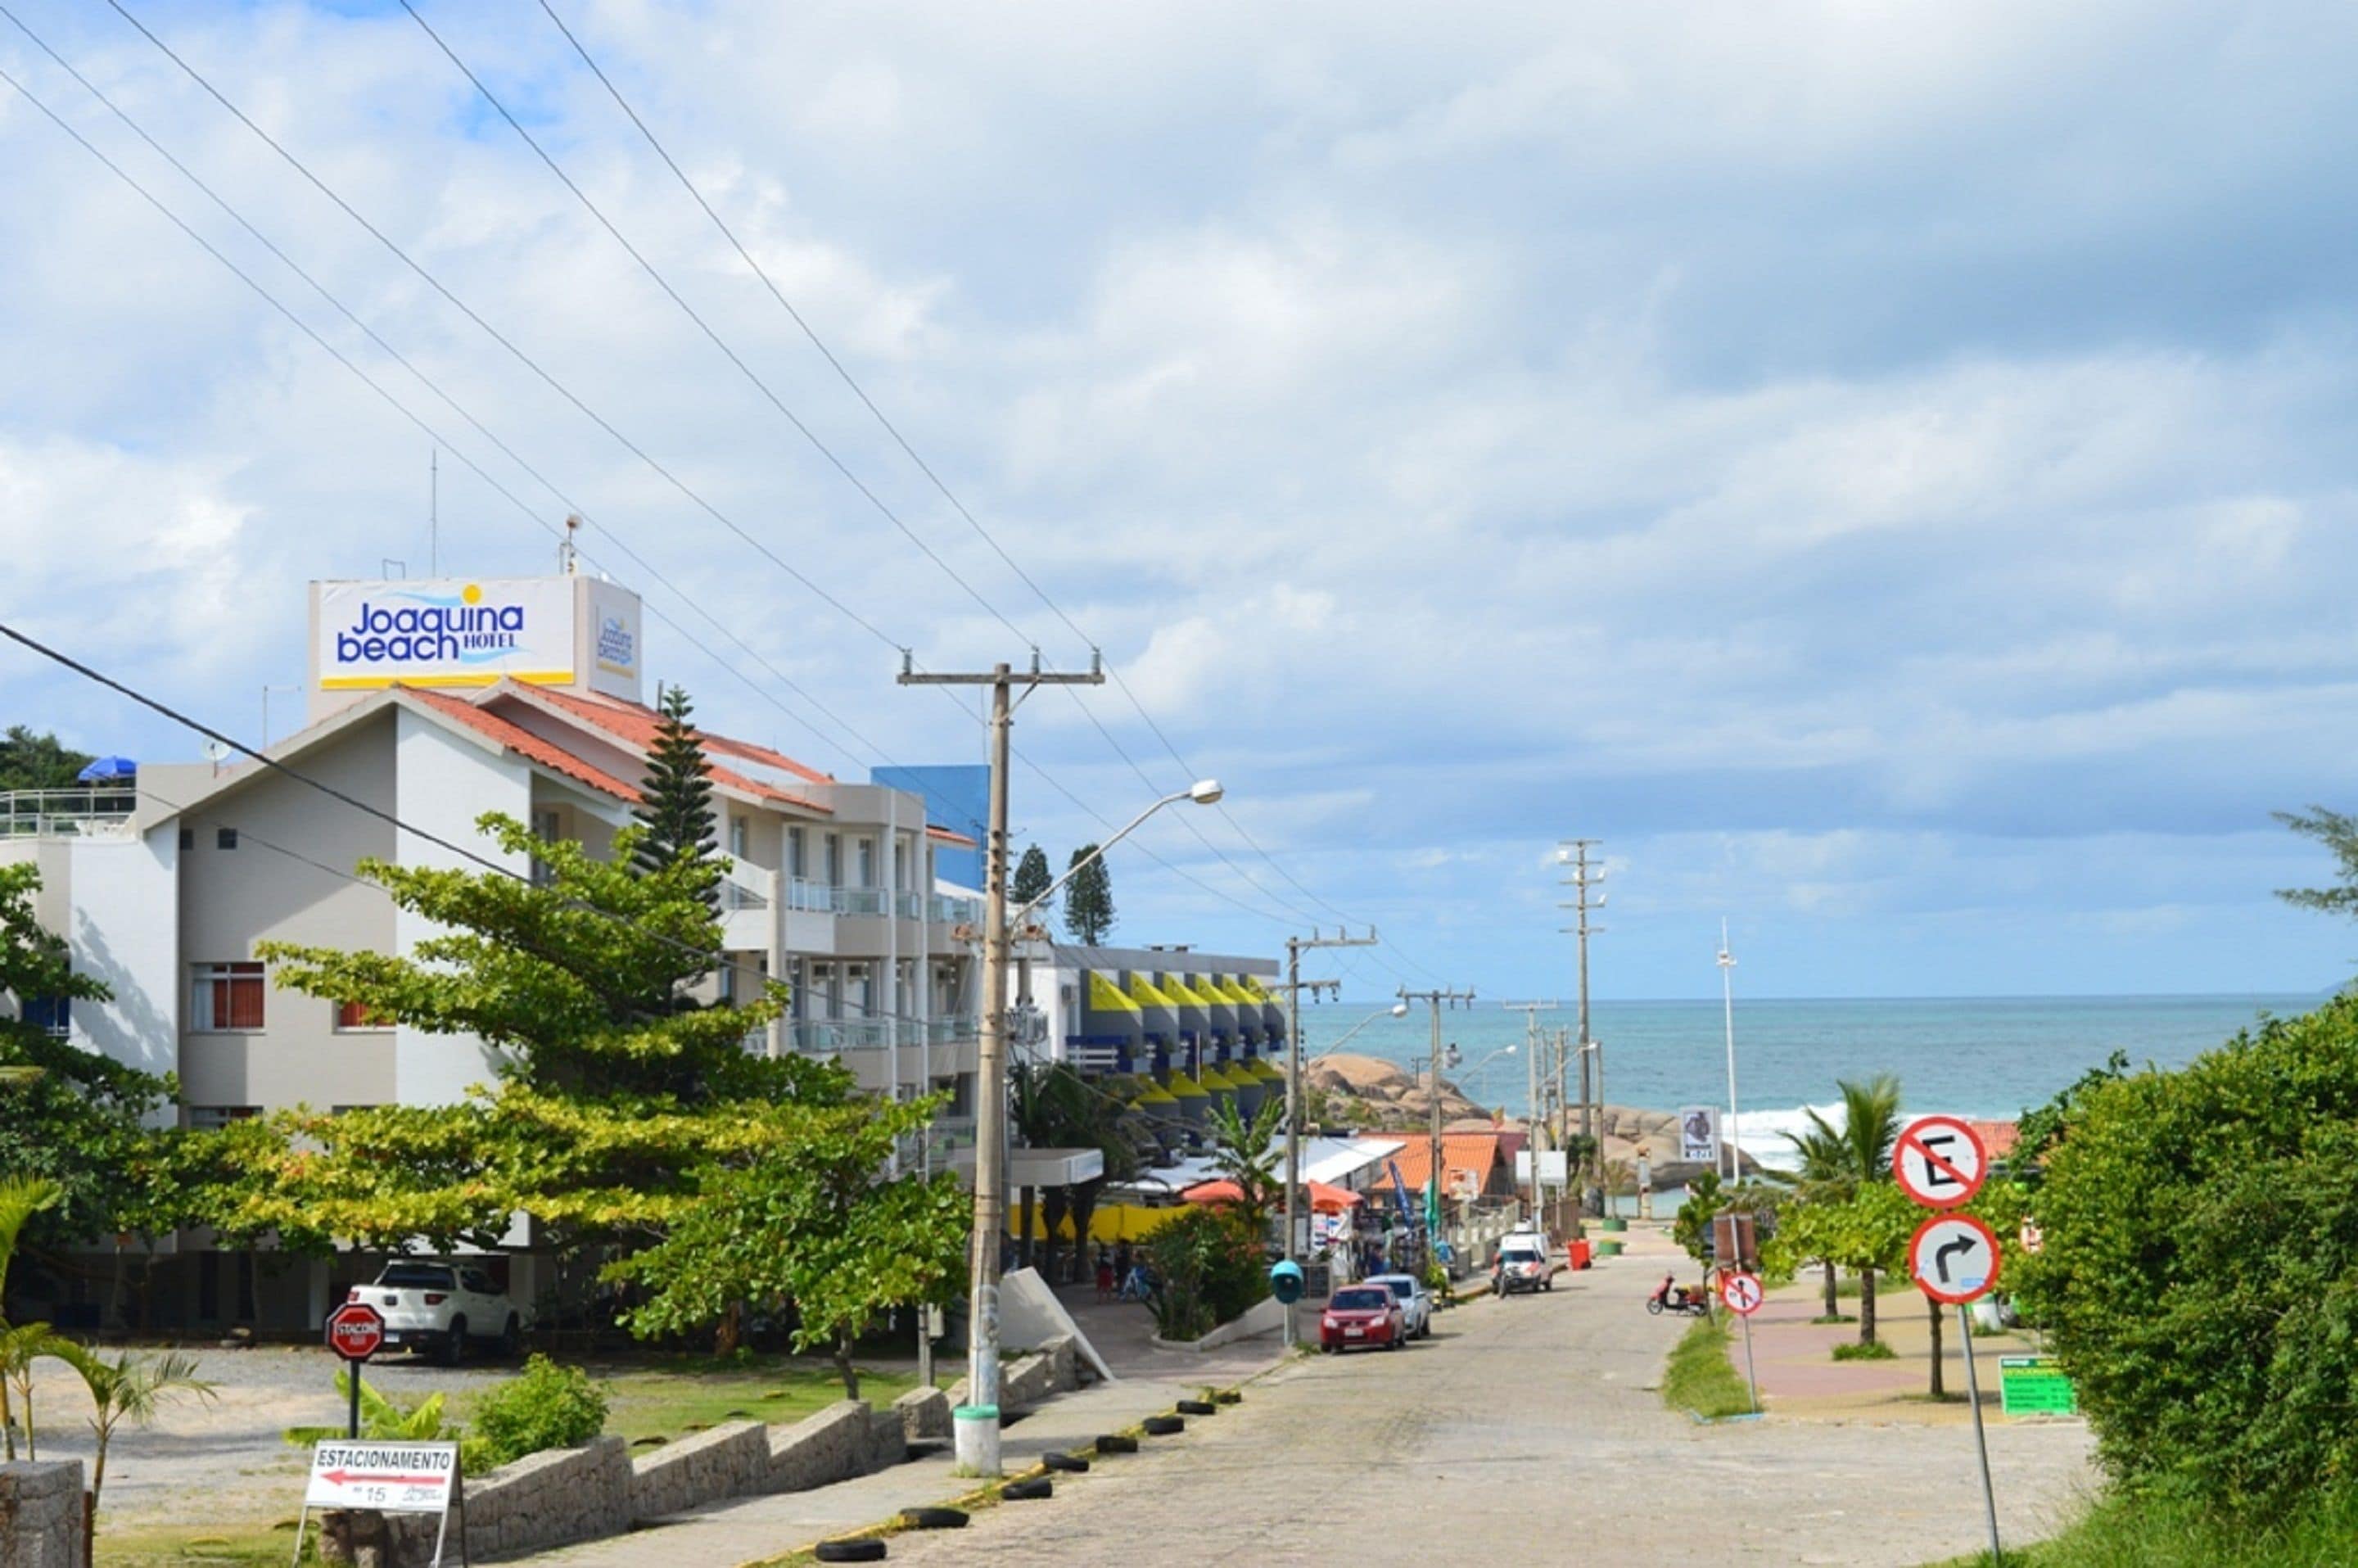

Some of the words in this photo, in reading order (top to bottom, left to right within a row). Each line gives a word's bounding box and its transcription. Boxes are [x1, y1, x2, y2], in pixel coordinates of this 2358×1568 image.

[351, 603, 523, 635] Joaquina
[337, 632, 459, 662] beach
[463, 633, 515, 648] HOTEL
[1922, 1135, 1958, 1186] E
[317, 1449, 450, 1469] ESTACIONAMENTO
[367, 1487, 386, 1502] 15
